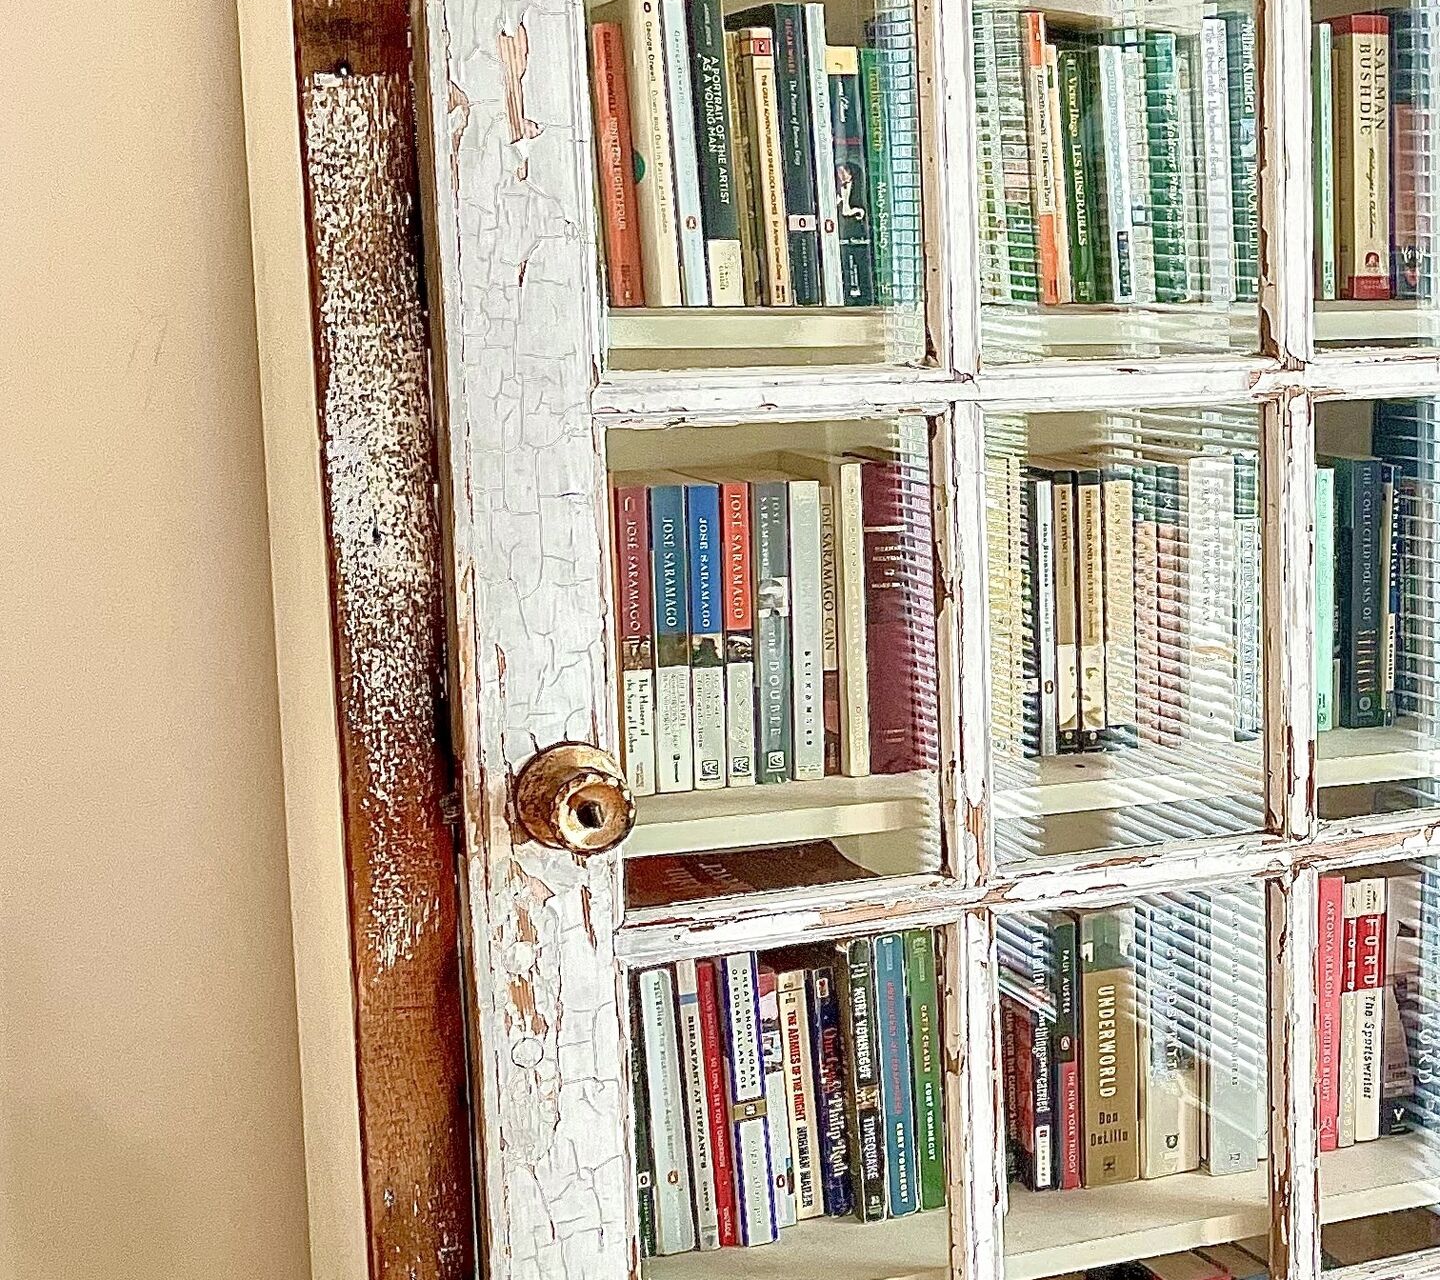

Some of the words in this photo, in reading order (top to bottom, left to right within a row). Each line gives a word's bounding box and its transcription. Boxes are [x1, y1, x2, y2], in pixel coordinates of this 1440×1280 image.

[645, 20, 654, 51] George
[1241, 22, 1253, 60] Milan
[647, 54, 657, 82] Orwell
[701, 55, 711, 72] AS
[704, 86, 715, 125] YOUNG
[711, 67, 724, 114] PORTRAIT
[1068, 76, 1079, 107] Victor
[1242, 62, 1256, 115] Kundera
[1359, 43, 1373, 136] RUSHDIE
[1373, 48, 1386, 130] SALMAN
[707, 127, 717, 153] MAN
[714, 125, 725, 141] OF
[1067, 108, 1079, 137] Hugo
[716, 144, 727, 164] THE
[1071, 144, 1082, 168] LES
[717, 166, 730, 205] ARTIST
[1362, 465, 1372, 489] THE
[1060, 488, 1068, 502] AS
[1084, 489, 1093, 508] THE
[1391, 488, 1400, 537] ARTHUR
[1061, 526, 1070, 554] DYING
[1085, 509, 1094, 540] SOUND
[1362, 490, 1373, 562] COLLECTED
[1085, 541, 1094, 561] AND
[1390, 543, 1398, 587] MILLER
[731, 534, 745, 620] SARAMAGO
[822, 532, 834, 612] SARAMAGO
[1086, 562, 1095, 579] THE
[1362, 563, 1373, 603] POEMS
[628, 555, 641, 631] SARAMAGO
[664, 552, 678, 627] SARAMAGO
[700, 554, 711, 628] SARAMAGO
[1086, 580, 1095, 606] FURY
[823, 617, 835, 651] CAIN
[638, 677, 648, 691] The
[768, 660, 782, 737] DOUBLE
[638, 694, 649, 725] History
[628, 725, 638, 754] Lisbon
[1325, 900, 1335, 953] ANTONYA
[1061, 949, 1070, 973] PAUL
[1364, 918, 1379, 987] FORD
[731, 968, 739, 983] OF
[741, 967, 750, 1002] GREAT
[1324, 955, 1334, 997] NELSON
[733, 986, 743, 1024] EDGAR
[854, 986, 867, 1018] KURT
[1062, 976, 1071, 1015] AUSTER
[1364, 995, 1377, 1017] The
[744, 1008, 753, 1044] SHORT
[787, 1009, 797, 1026] THE
[687, 1015, 700, 1086] BREAKFAST
[736, 1029, 745, 1065] ALLAN
[787, 1027, 801, 1065] ARMIES
[855, 1019, 872, 1080] VONNEGUT
[922, 1034, 932, 1073] CRADLE
[1032, 1026, 1048, 1058] things
[1097, 984, 1117, 1098] UNDERWORLD
[1322, 1013, 1332, 1065] NOTHING
[747, 1048, 758, 1087] WORKS
[1361, 1022, 1377, 1100] Sportswriter
[739, 1068, 748, 1090] POE
[792, 1077, 803, 1092] THE
[925, 1081, 934, 1108] KURT
[1036, 1077, 1051, 1113] carried
[1067, 1070, 1075, 1088] THE
[1322, 1066, 1332, 1101] RIGHT
[694, 1089, 702, 1105] AT
[794, 1092, 806, 1121] NIGHT
[1068, 1090, 1076, 1111] NEW
[714, 1108, 722, 1125] YOU
[828, 1091, 845, 1143] Philip
[1067, 1111, 1077, 1137] YORK
[1098, 1111, 1119, 1127] Don
[694, 1106, 707, 1169] TIFFANY'S
[715, 1125, 726, 1168] TOMORROW
[796, 1125, 809, 1169] NORMAN
[863, 1116, 879, 1181] TIMEQUAKE
[896, 1122, 905, 1149] KURT
[926, 1110, 937, 1162] VONNEGUT
[1089, 1130, 1129, 1147] DeLillo
[831, 1143, 848, 1178] Roth
[1067, 1139, 1077, 1174] TRILOGY
[800, 1171, 814, 1209] MAILER
[898, 1150, 910, 1204] VONNEGUT
